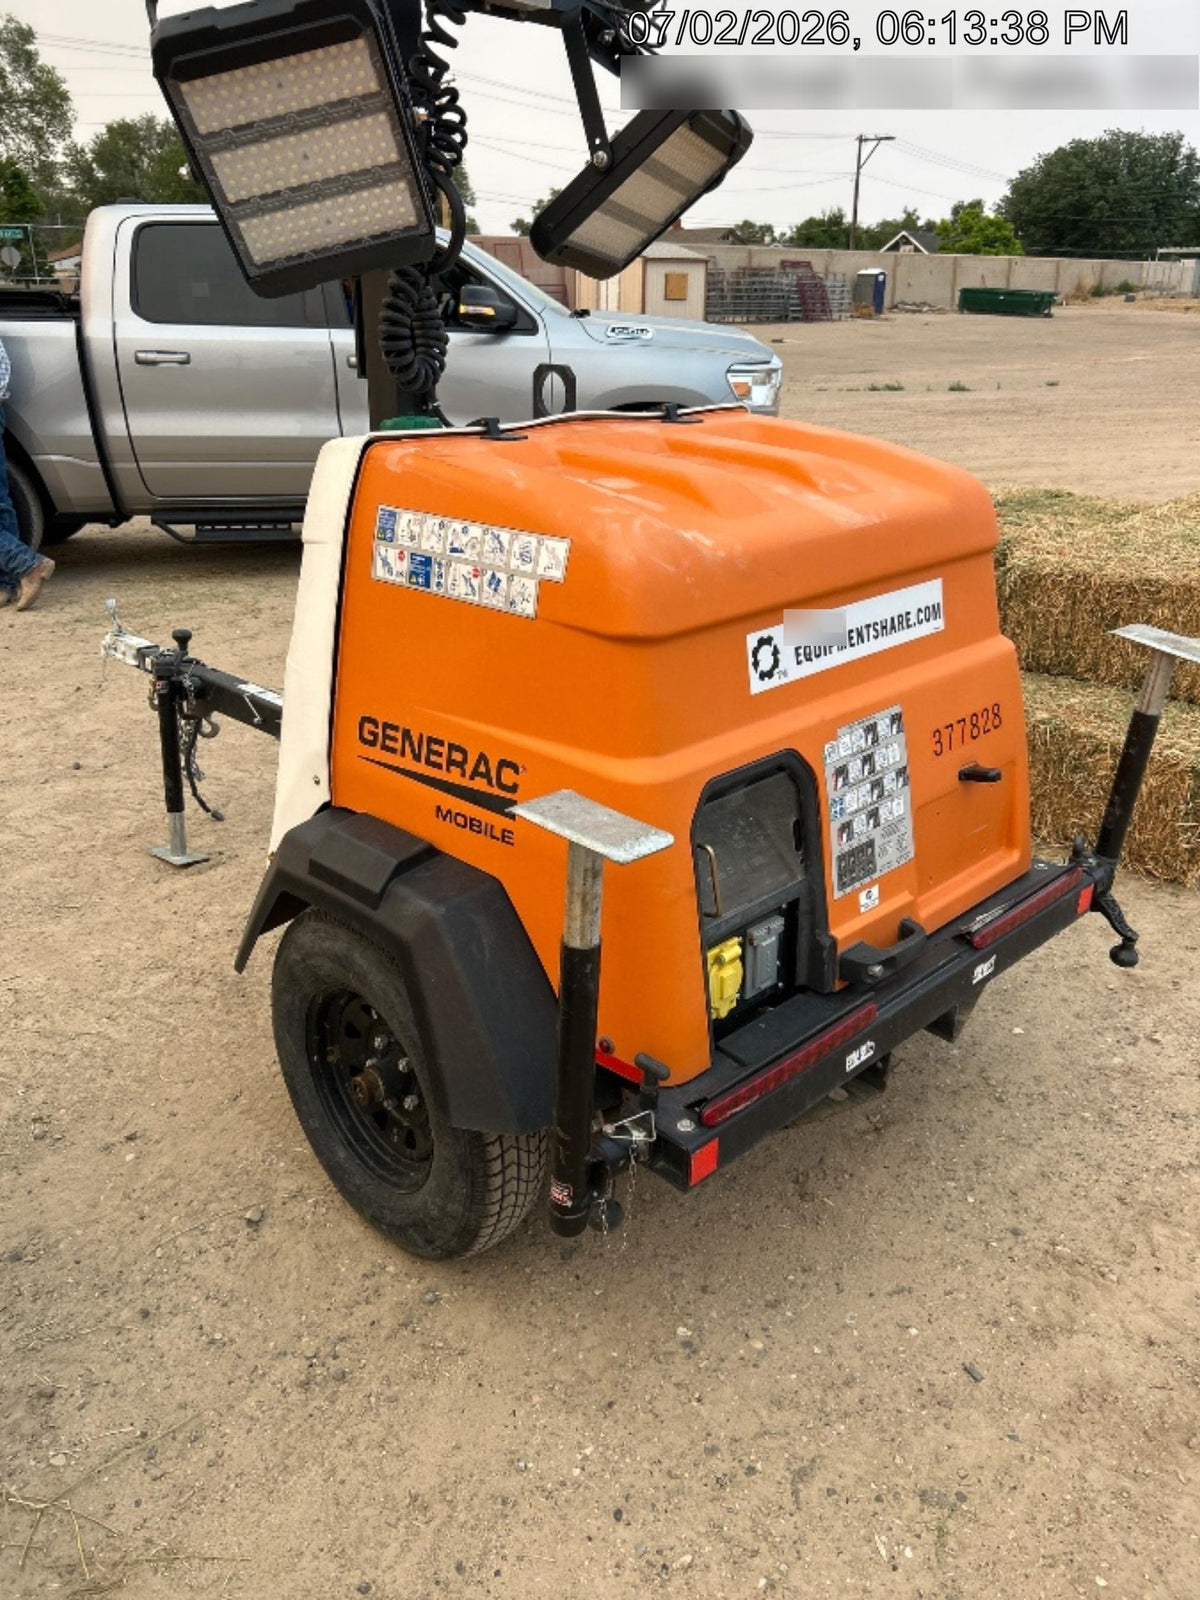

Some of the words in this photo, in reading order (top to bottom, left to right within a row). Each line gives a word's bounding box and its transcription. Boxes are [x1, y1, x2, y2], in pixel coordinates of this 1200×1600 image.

[358, 715, 520, 795] GENERAC
[932, 703, 1002, 757] 377828
[435, 805, 515, 847] MOBILE
